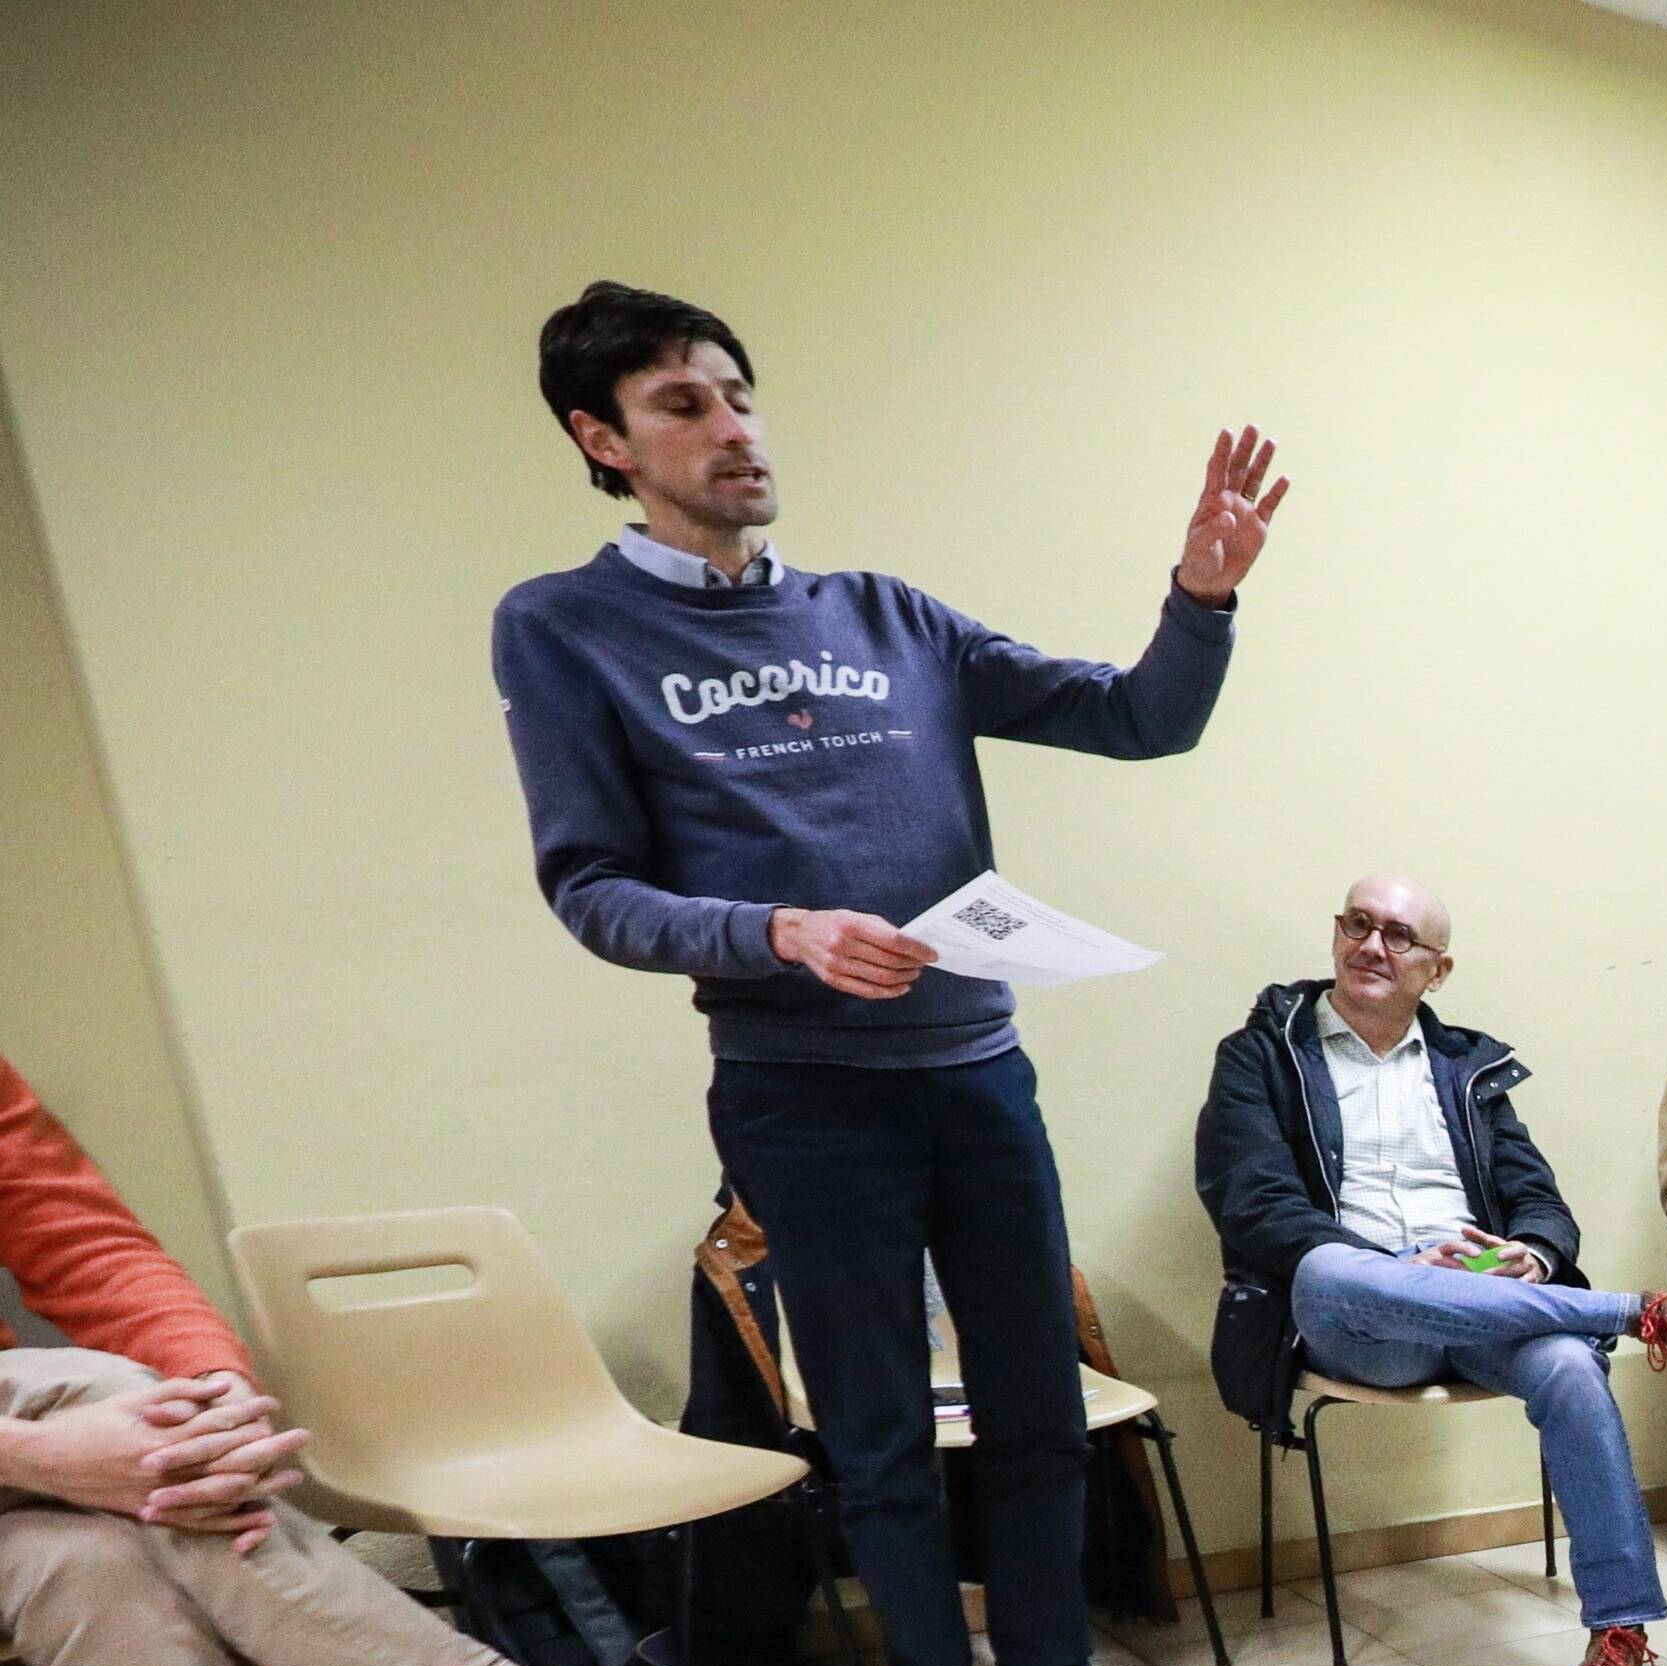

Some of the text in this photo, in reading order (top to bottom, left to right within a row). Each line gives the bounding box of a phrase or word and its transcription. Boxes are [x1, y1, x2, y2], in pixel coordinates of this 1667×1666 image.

[661, 651, 889, 724] Cocorico
[736, 732, 884, 760] FRENCH TOUCH
